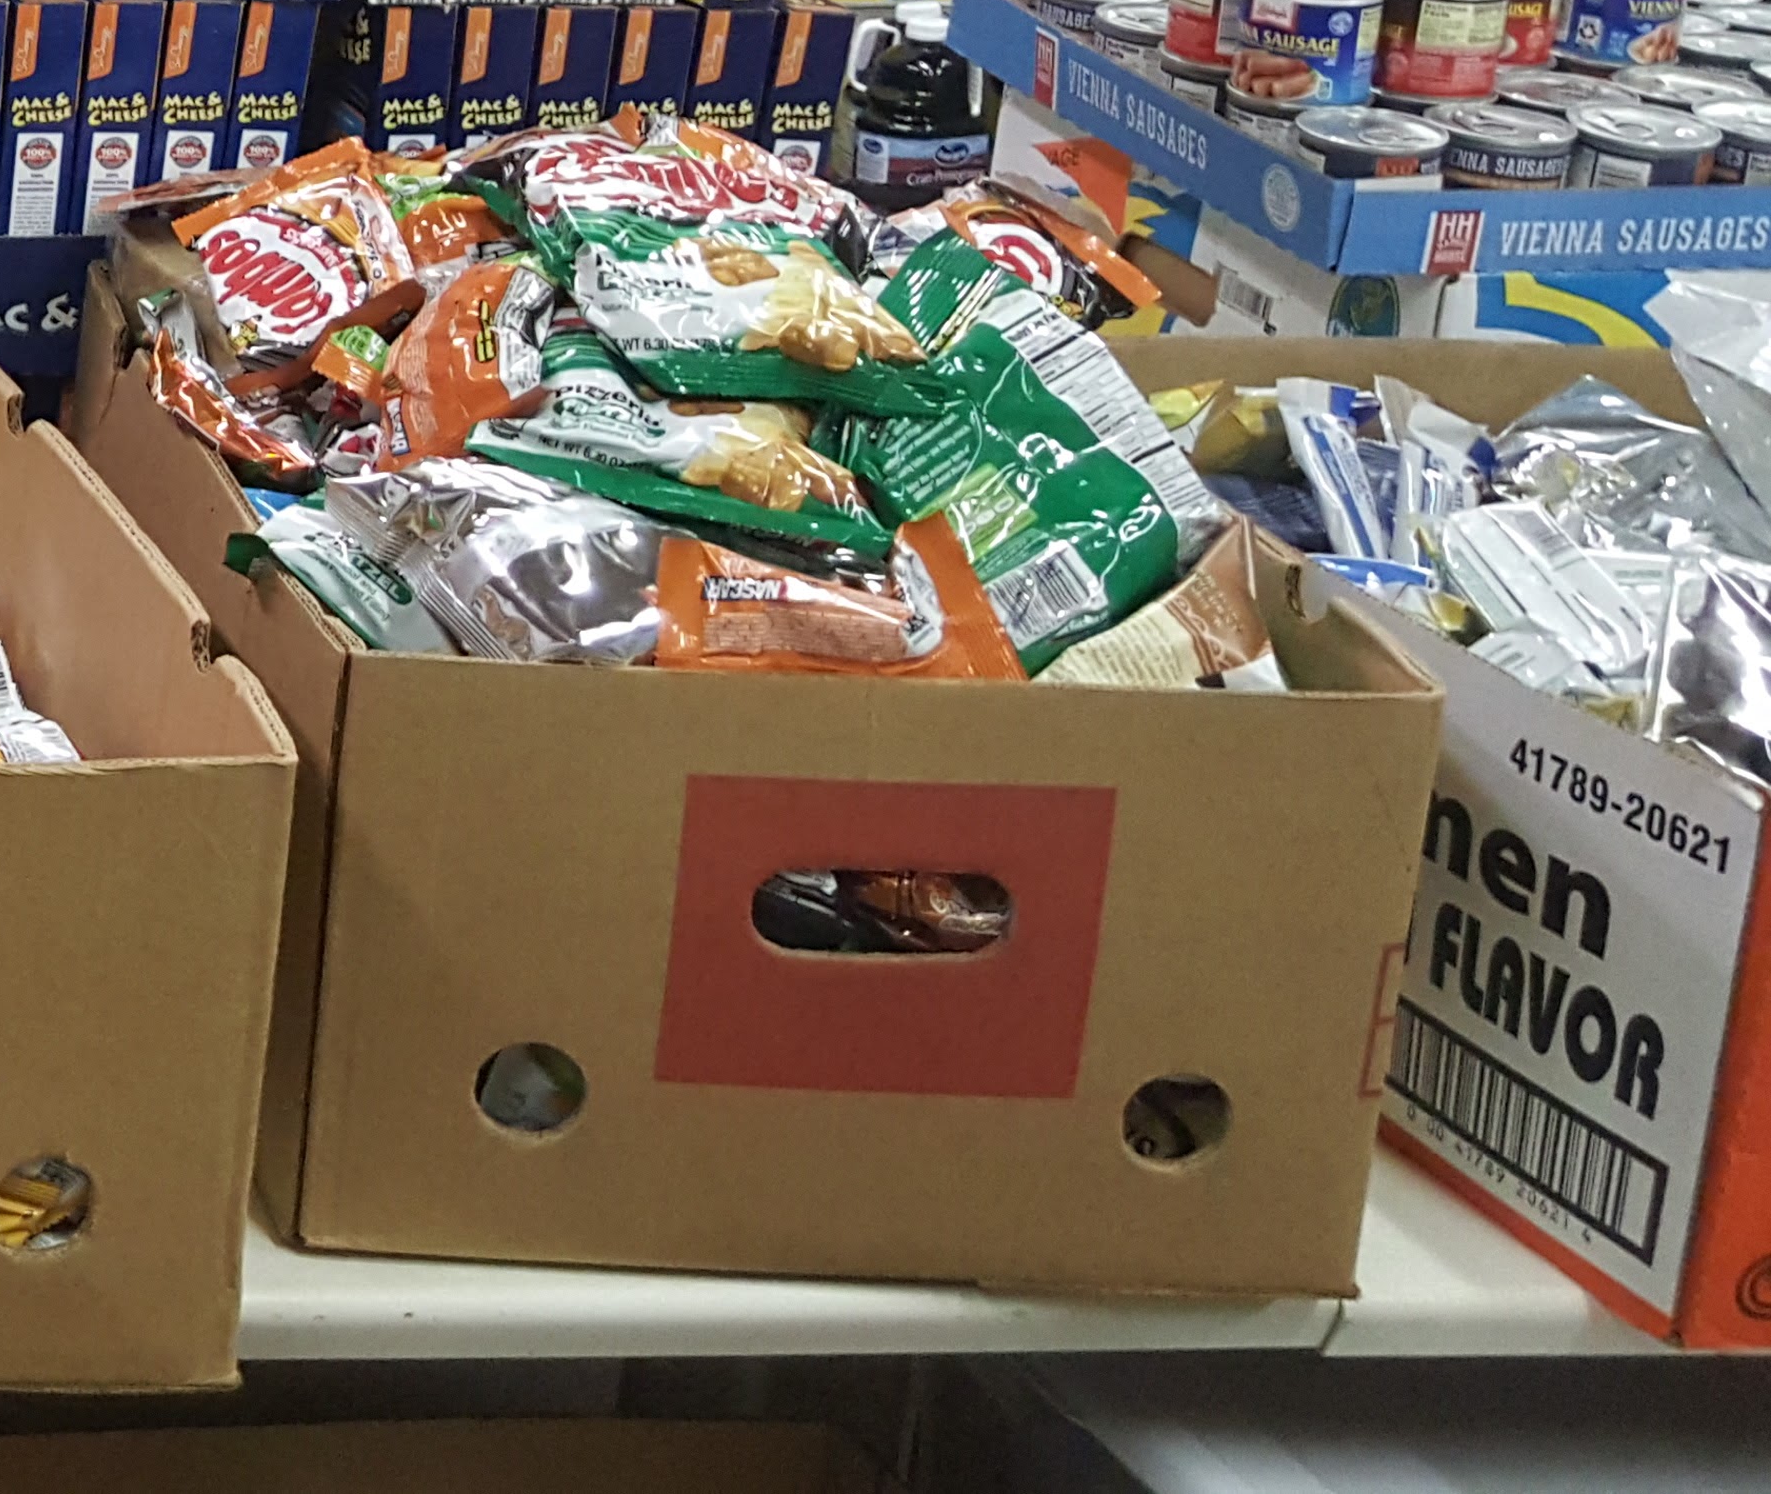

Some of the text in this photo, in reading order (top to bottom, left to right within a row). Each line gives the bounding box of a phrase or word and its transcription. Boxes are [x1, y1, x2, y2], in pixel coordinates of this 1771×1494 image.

[1263, 28, 1340, 54] SAUSAGE
[773, 114, 833, 132] CHEESE
[774, 102, 812, 116] MAC
[1068, 57, 1209, 170] VIENNA SAUSAGES
[1501, 220, 1602, 256] VIENNA
[1618, 216, 1769, 253] SAUSAGES
[42, 293, 78, 330] &
[1509, 738, 1732, 875] 41789-20621
[1429, 903, 1664, 1121] FLAVOR
